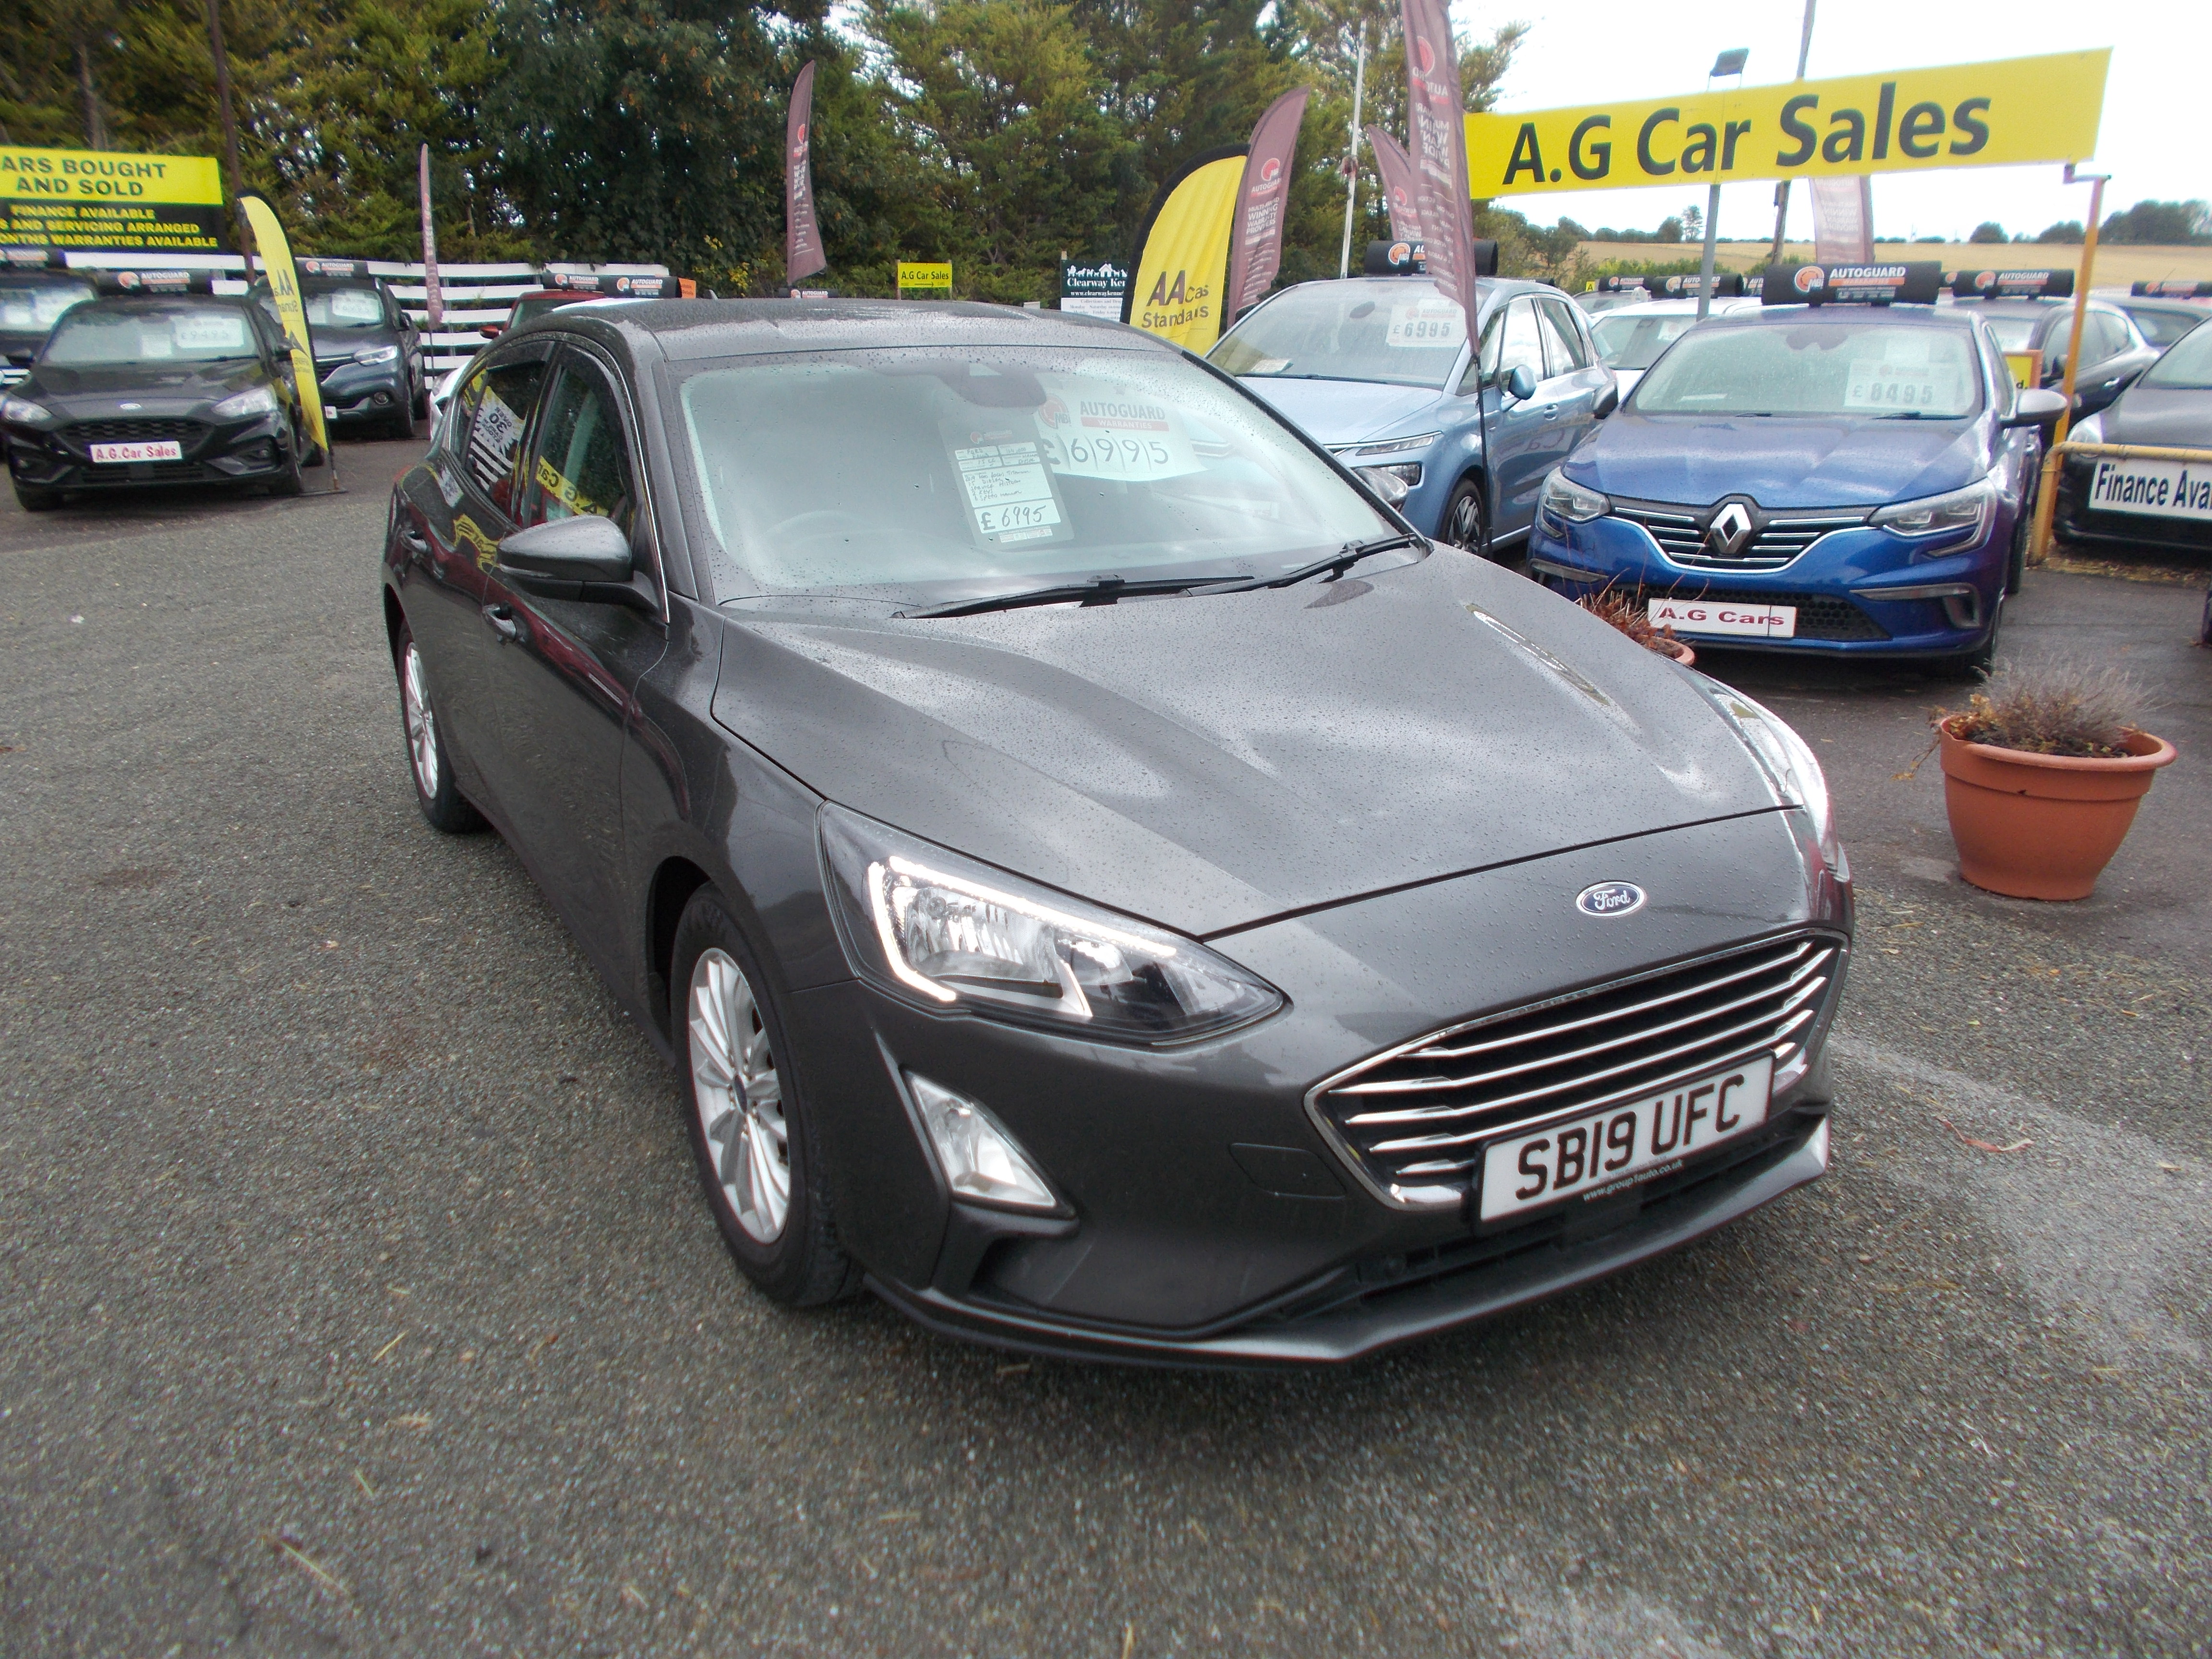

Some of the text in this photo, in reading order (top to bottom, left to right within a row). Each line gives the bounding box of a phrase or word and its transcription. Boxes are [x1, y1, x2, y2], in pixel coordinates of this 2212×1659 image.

[1502, 114, 1611, 185] A.G
[1636, 107, 1752, 176] Car
[1776, 82, 1991, 167] Sales
[2, 155, 166, 178] ARS BOUGHT
[16, 177, 144, 195] AND SOLD
[9, 204, 156, 219] FINANCE AVAILABLE
[11, 219, 44, 230] AND
[46, 221, 124, 232] SERVICING
[126, 222, 200, 234] ARRANGED
[51, 234, 144, 246] WARRANTIES
[146, 236, 218, 247] AVAILABLE
[902, 271, 949, 279] A.G Car Sales
[1830, 266, 1906, 278] AUTOGUARD
[1067, 277, 1107, 288] Clearway
[1404, 321, 1451, 337] 6995
[1080, 401, 1166, 420] AUTOGUARD
[1098, 420, 1152, 429] WARRANTIES
[146, 445, 177, 457] Sales
[1070, 438, 1169, 465] 6995
[2094, 463, 2212, 510] Finance Ava
[981, 505, 1046, 531] £ 6995
[1659, 607, 1785, 625] A.G Cars
[1593, 889, 1631, 910] Ford
[1515, 1073, 1745, 1201] SB19 UFC
[1583, 1159, 1683, 1201] www.group1auto.co.uk
